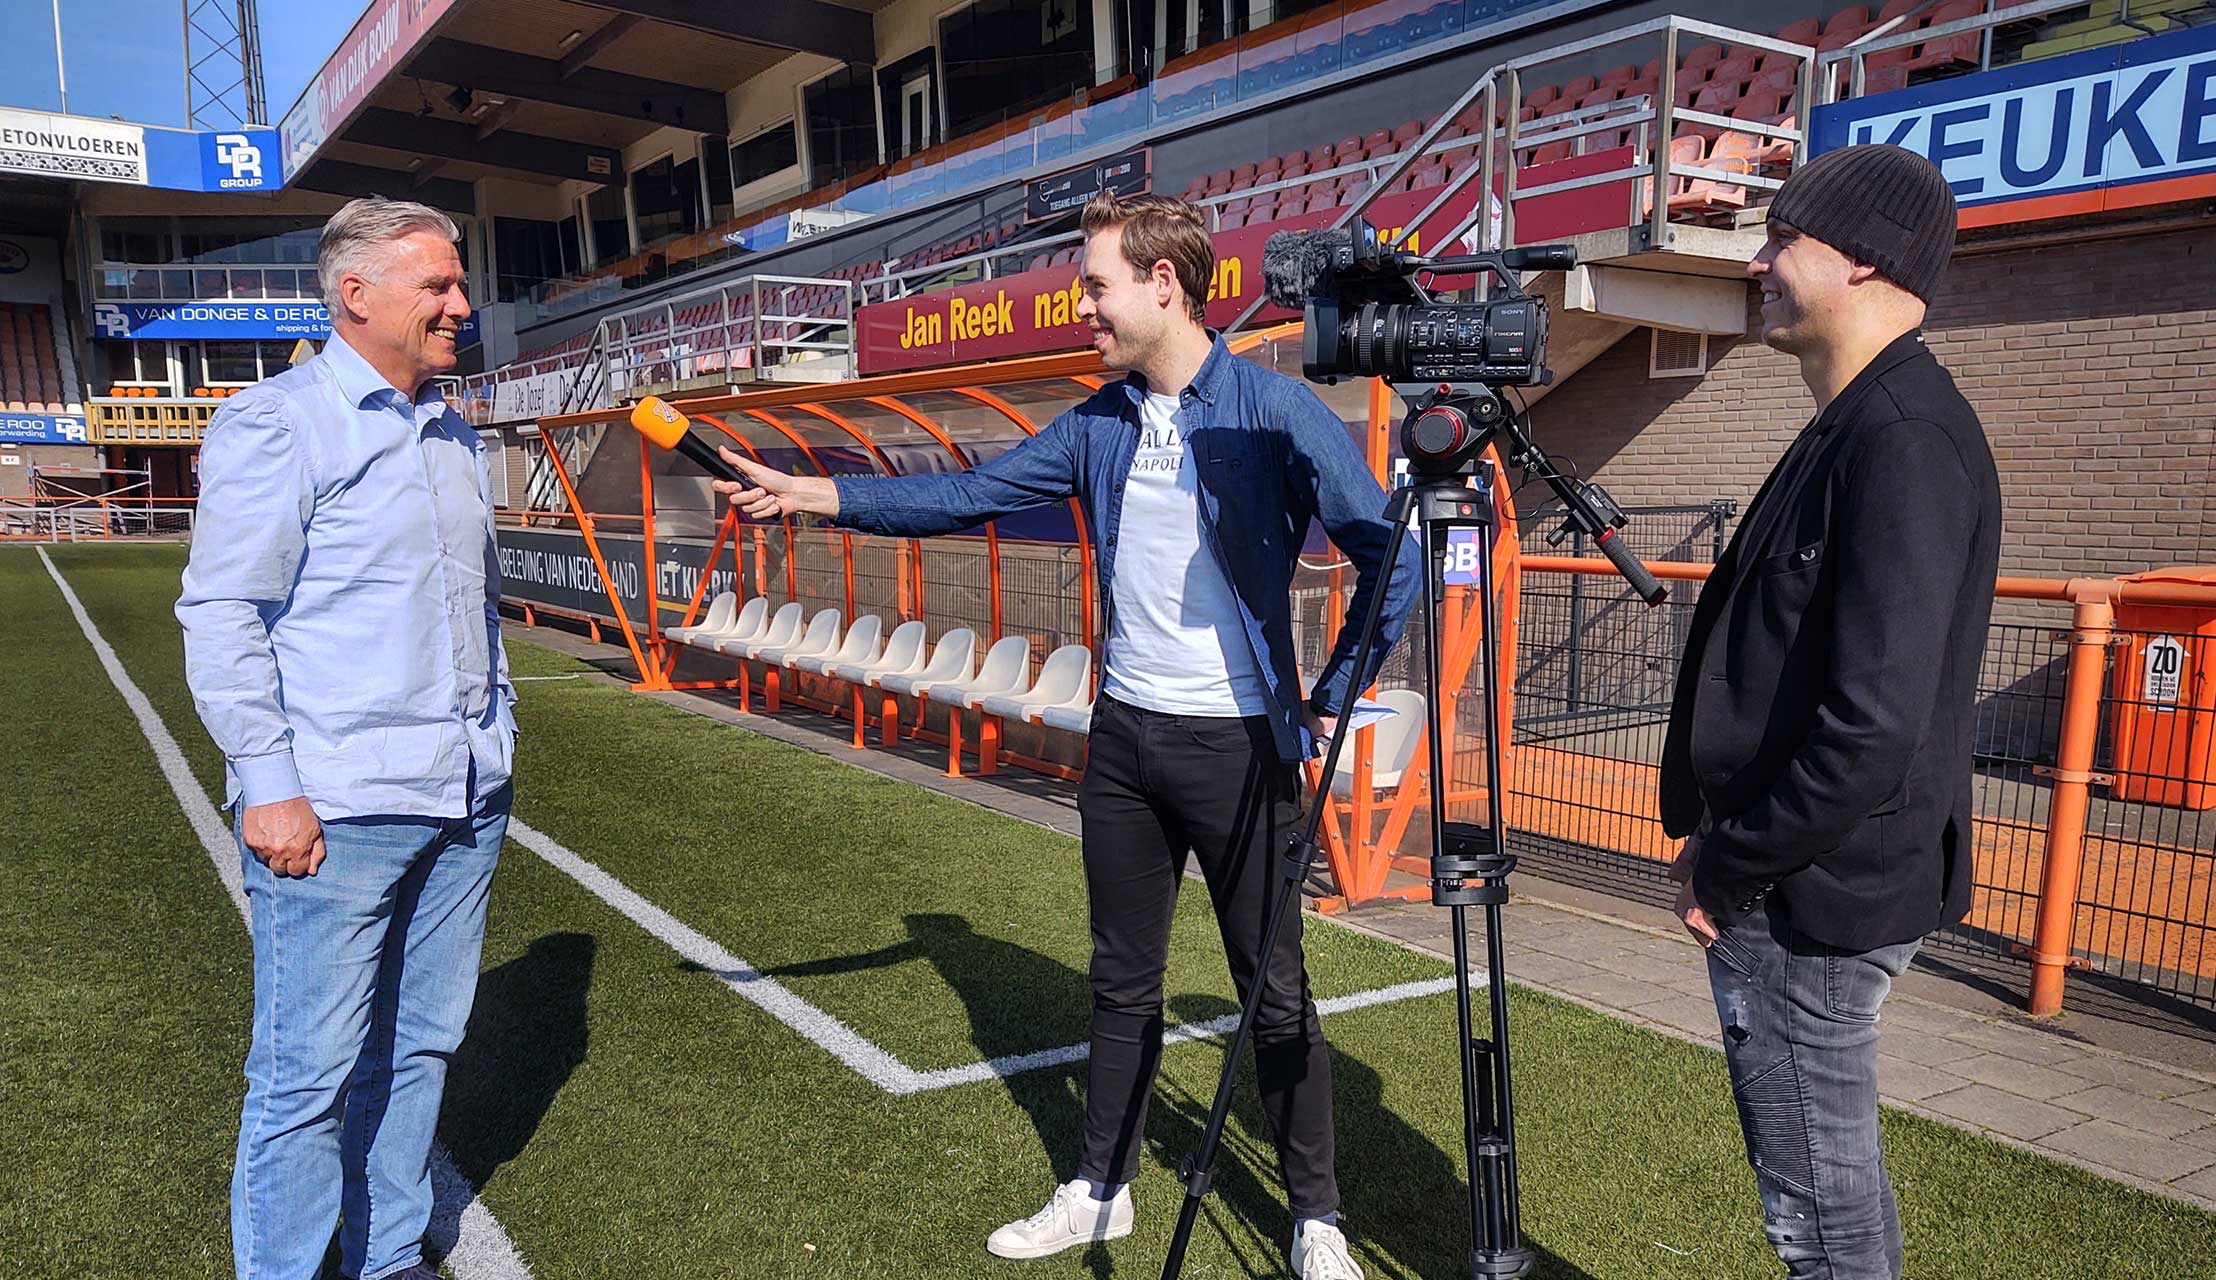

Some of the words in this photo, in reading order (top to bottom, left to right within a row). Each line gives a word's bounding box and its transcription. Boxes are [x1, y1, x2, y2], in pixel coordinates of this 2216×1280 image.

[329, 63, 347, 112] VAN
[369, 0, 399, 69] BOUW
[0, 127, 139, 157] ETONVLOEREN
[219, 178, 263, 188] GROUP
[135, 307, 175, 320] VAN
[181, 307, 249, 320] DONGE
[254, 307, 269, 320] &
[899, 307, 942, 350] Jan
[950, 290, 1014, 341] Reek
[1034, 275, 1086, 329] nat
[275, 323, 310, 333] shipping
[515, 383, 524, 413] De
[526, 378, 545, 418] Jozef
[7, 419, 45, 430] ROO
[1132, 457, 1184, 472] NAPOLI
[544, 552, 567, 588] VAN
[2151, 645, 2177, 674] ZO
